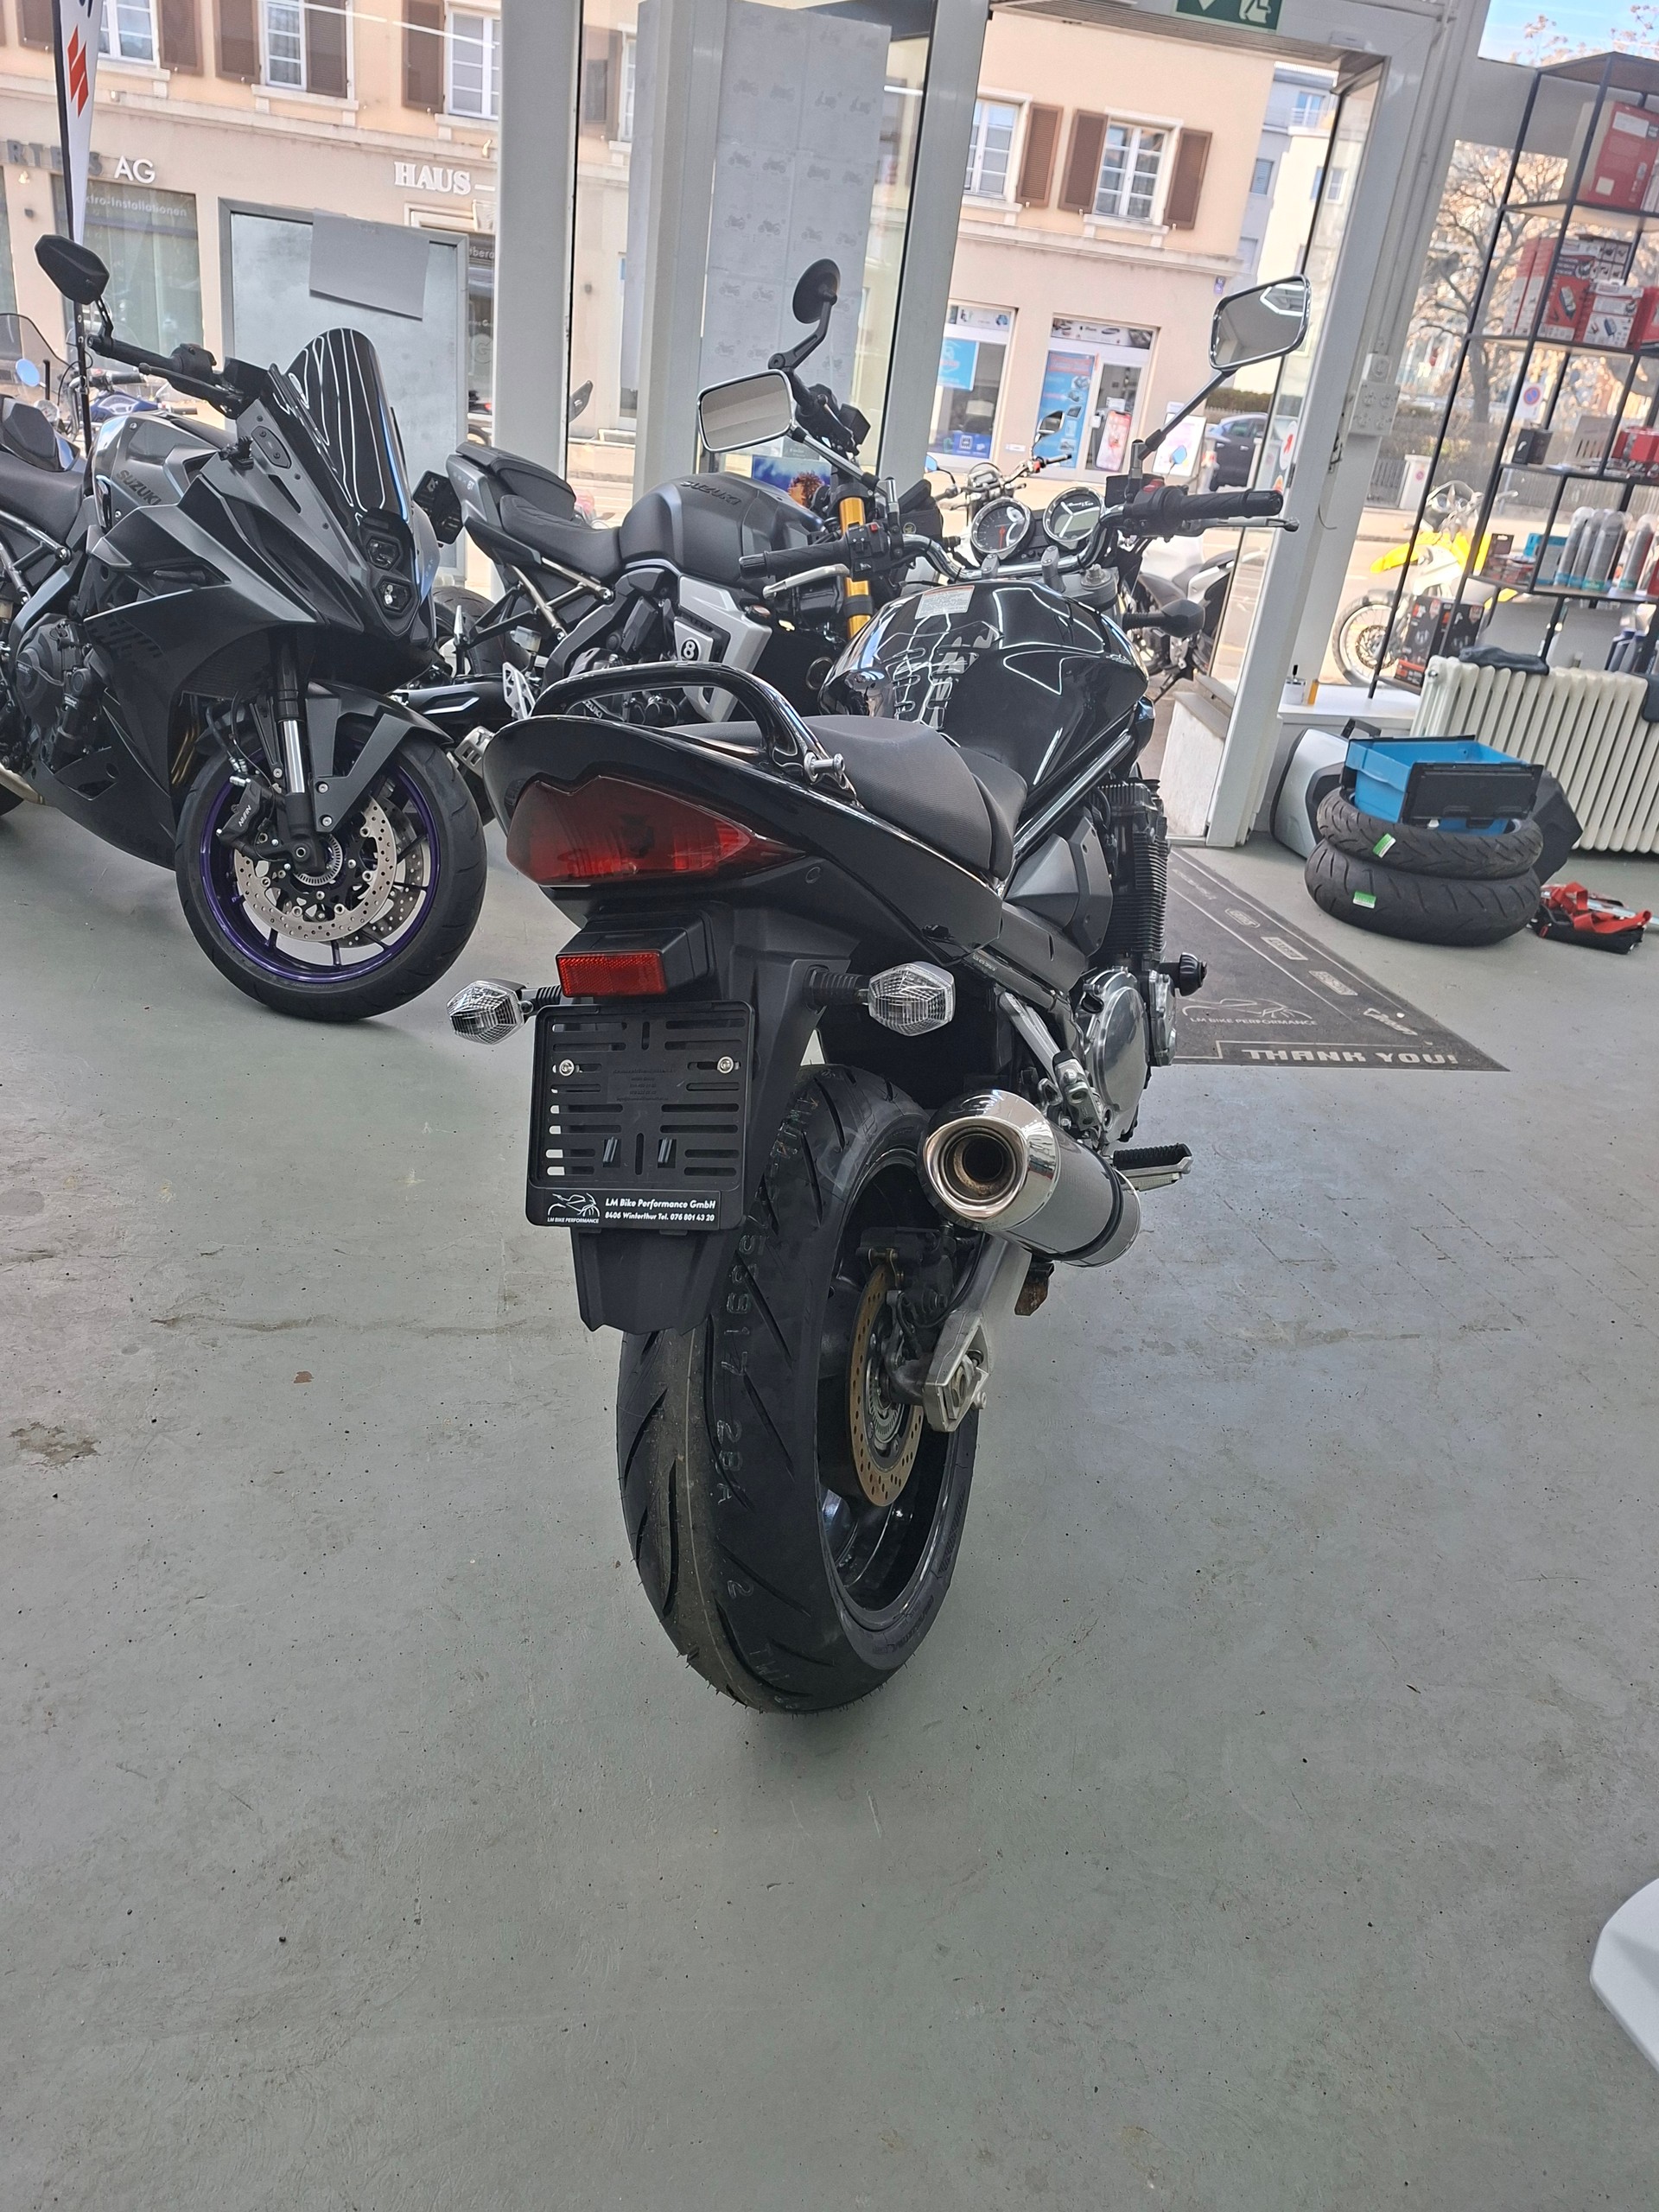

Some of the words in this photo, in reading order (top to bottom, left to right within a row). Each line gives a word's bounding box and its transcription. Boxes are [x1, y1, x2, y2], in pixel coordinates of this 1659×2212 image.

[114, 156, 156, 184] AG
[394, 161, 471, 195] HAUS
[117, 469, 162, 505] SUZUKI
[680, 480, 741, 505] SUZUKI
[683, 640, 696, 659] 8
[582, 699, 603, 719] ZUKI
[1241, 1048, 1367, 1063] THANK
[1375, 1051, 1459, 1065] YOU!
[606, 1198, 619, 1207] LM
[620, 1198, 637, 1207] Bike
[638, 1198, 689, 1211] Performance
[690, 1199, 716, 1209] GmbH
